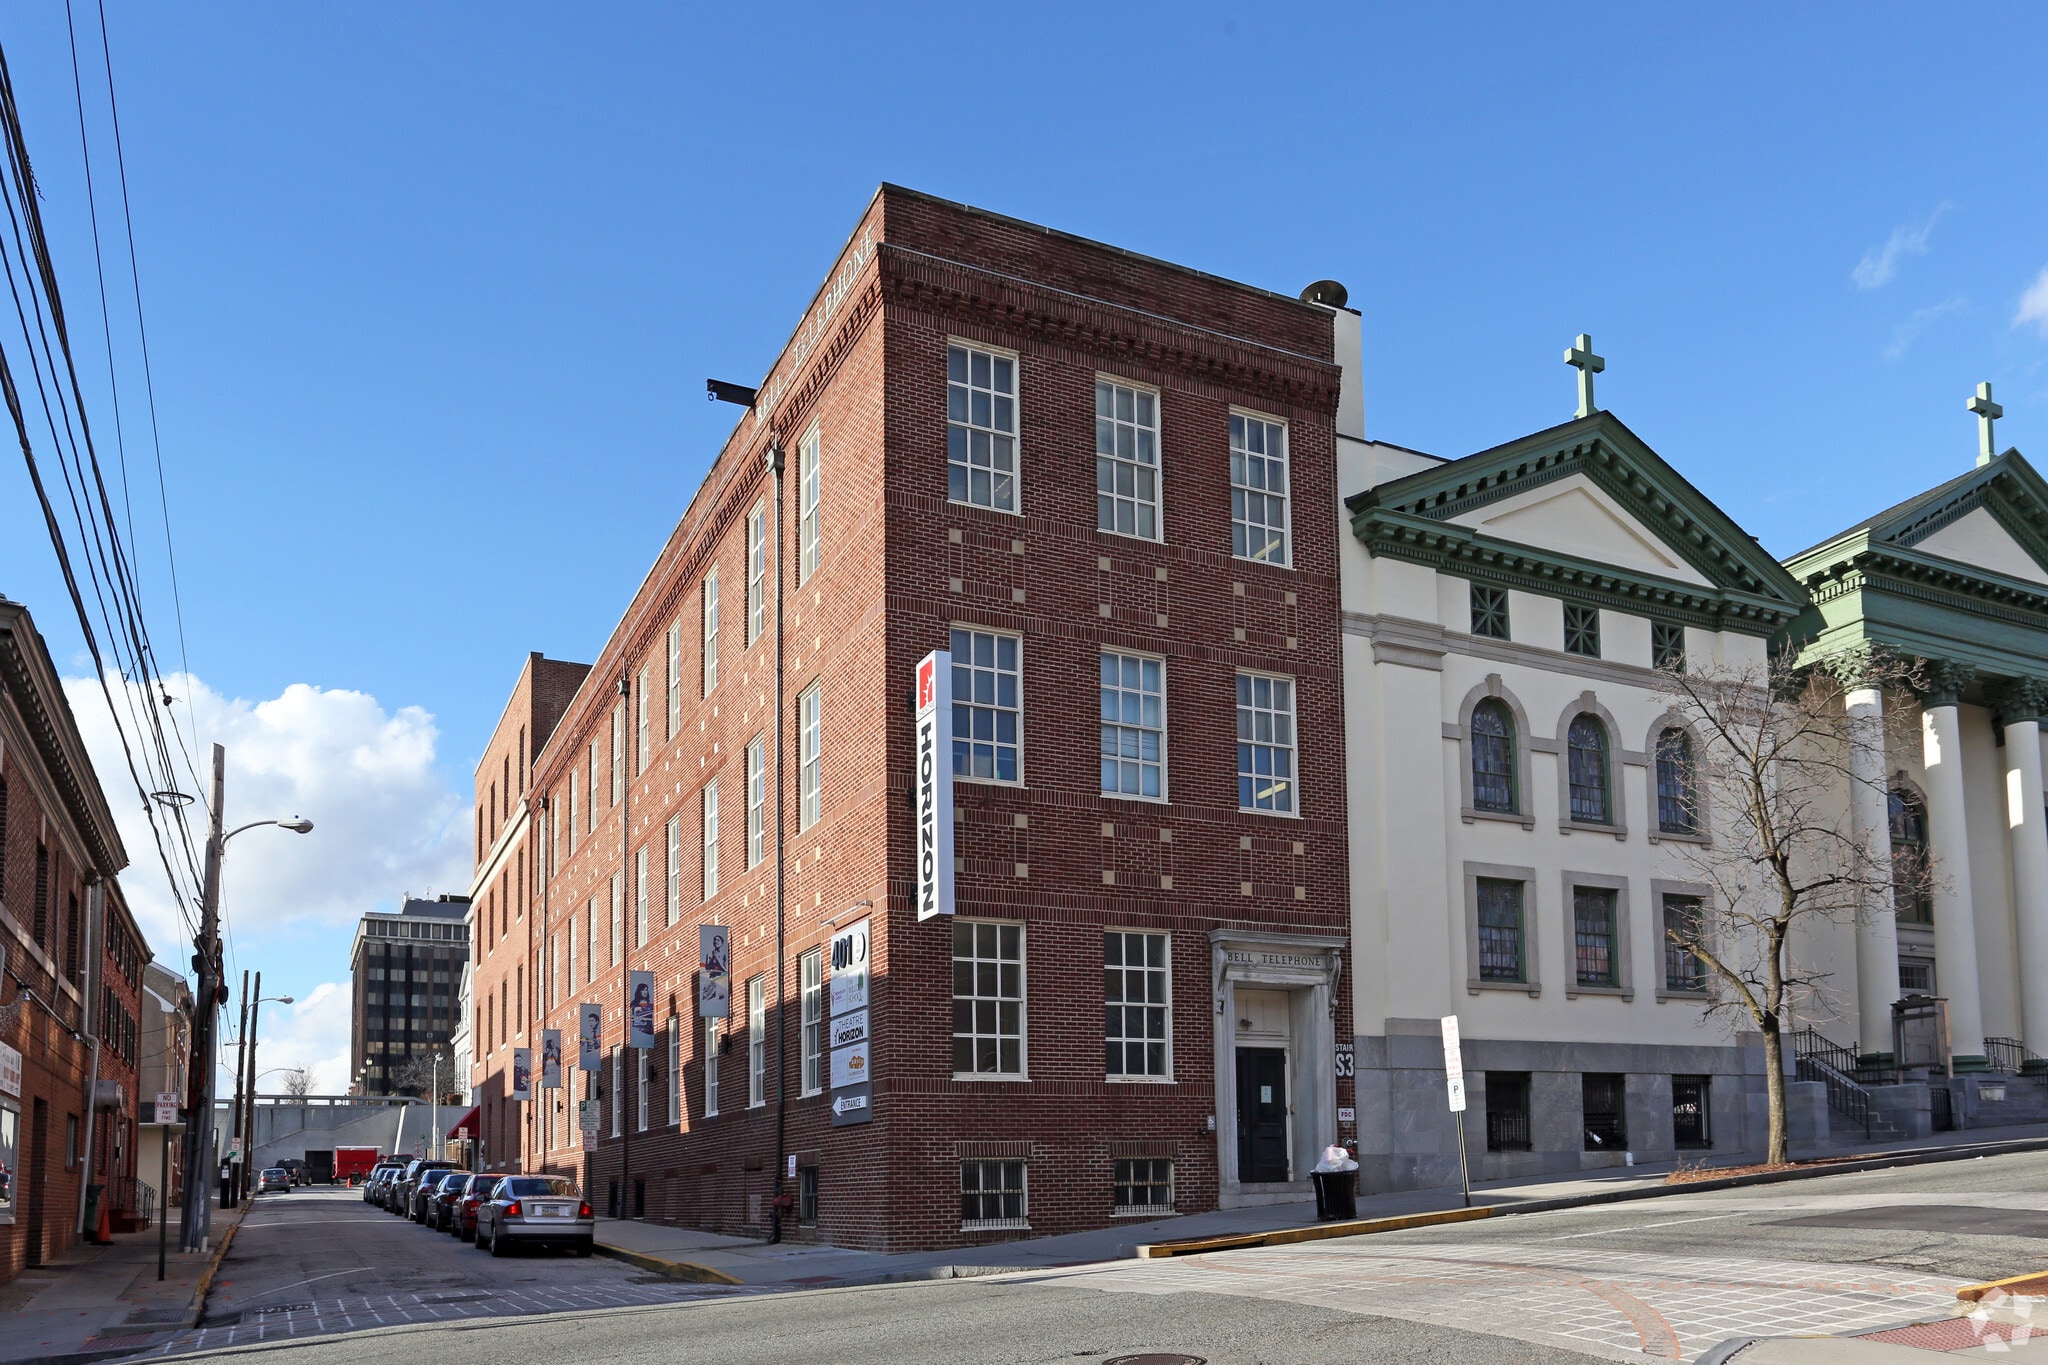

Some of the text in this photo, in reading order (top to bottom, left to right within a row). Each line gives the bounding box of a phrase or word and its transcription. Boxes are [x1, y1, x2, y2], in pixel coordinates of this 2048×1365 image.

[793, 224, 874, 366] TELEPHONE
[921, 721, 934, 912] HORIZON
[831, 934, 853, 971] 401
[1227, 952, 1321, 967] BELL TELEPHONE
[838, 1013, 864, 1030] THEATRE
[838, 1025, 864, 1044] HORIZON
[1335, 1043, 1354, 1052] STAIR
[1335, 1053, 1355, 1077] S3
[840, 1098, 861, 1111] ENTRANCE
